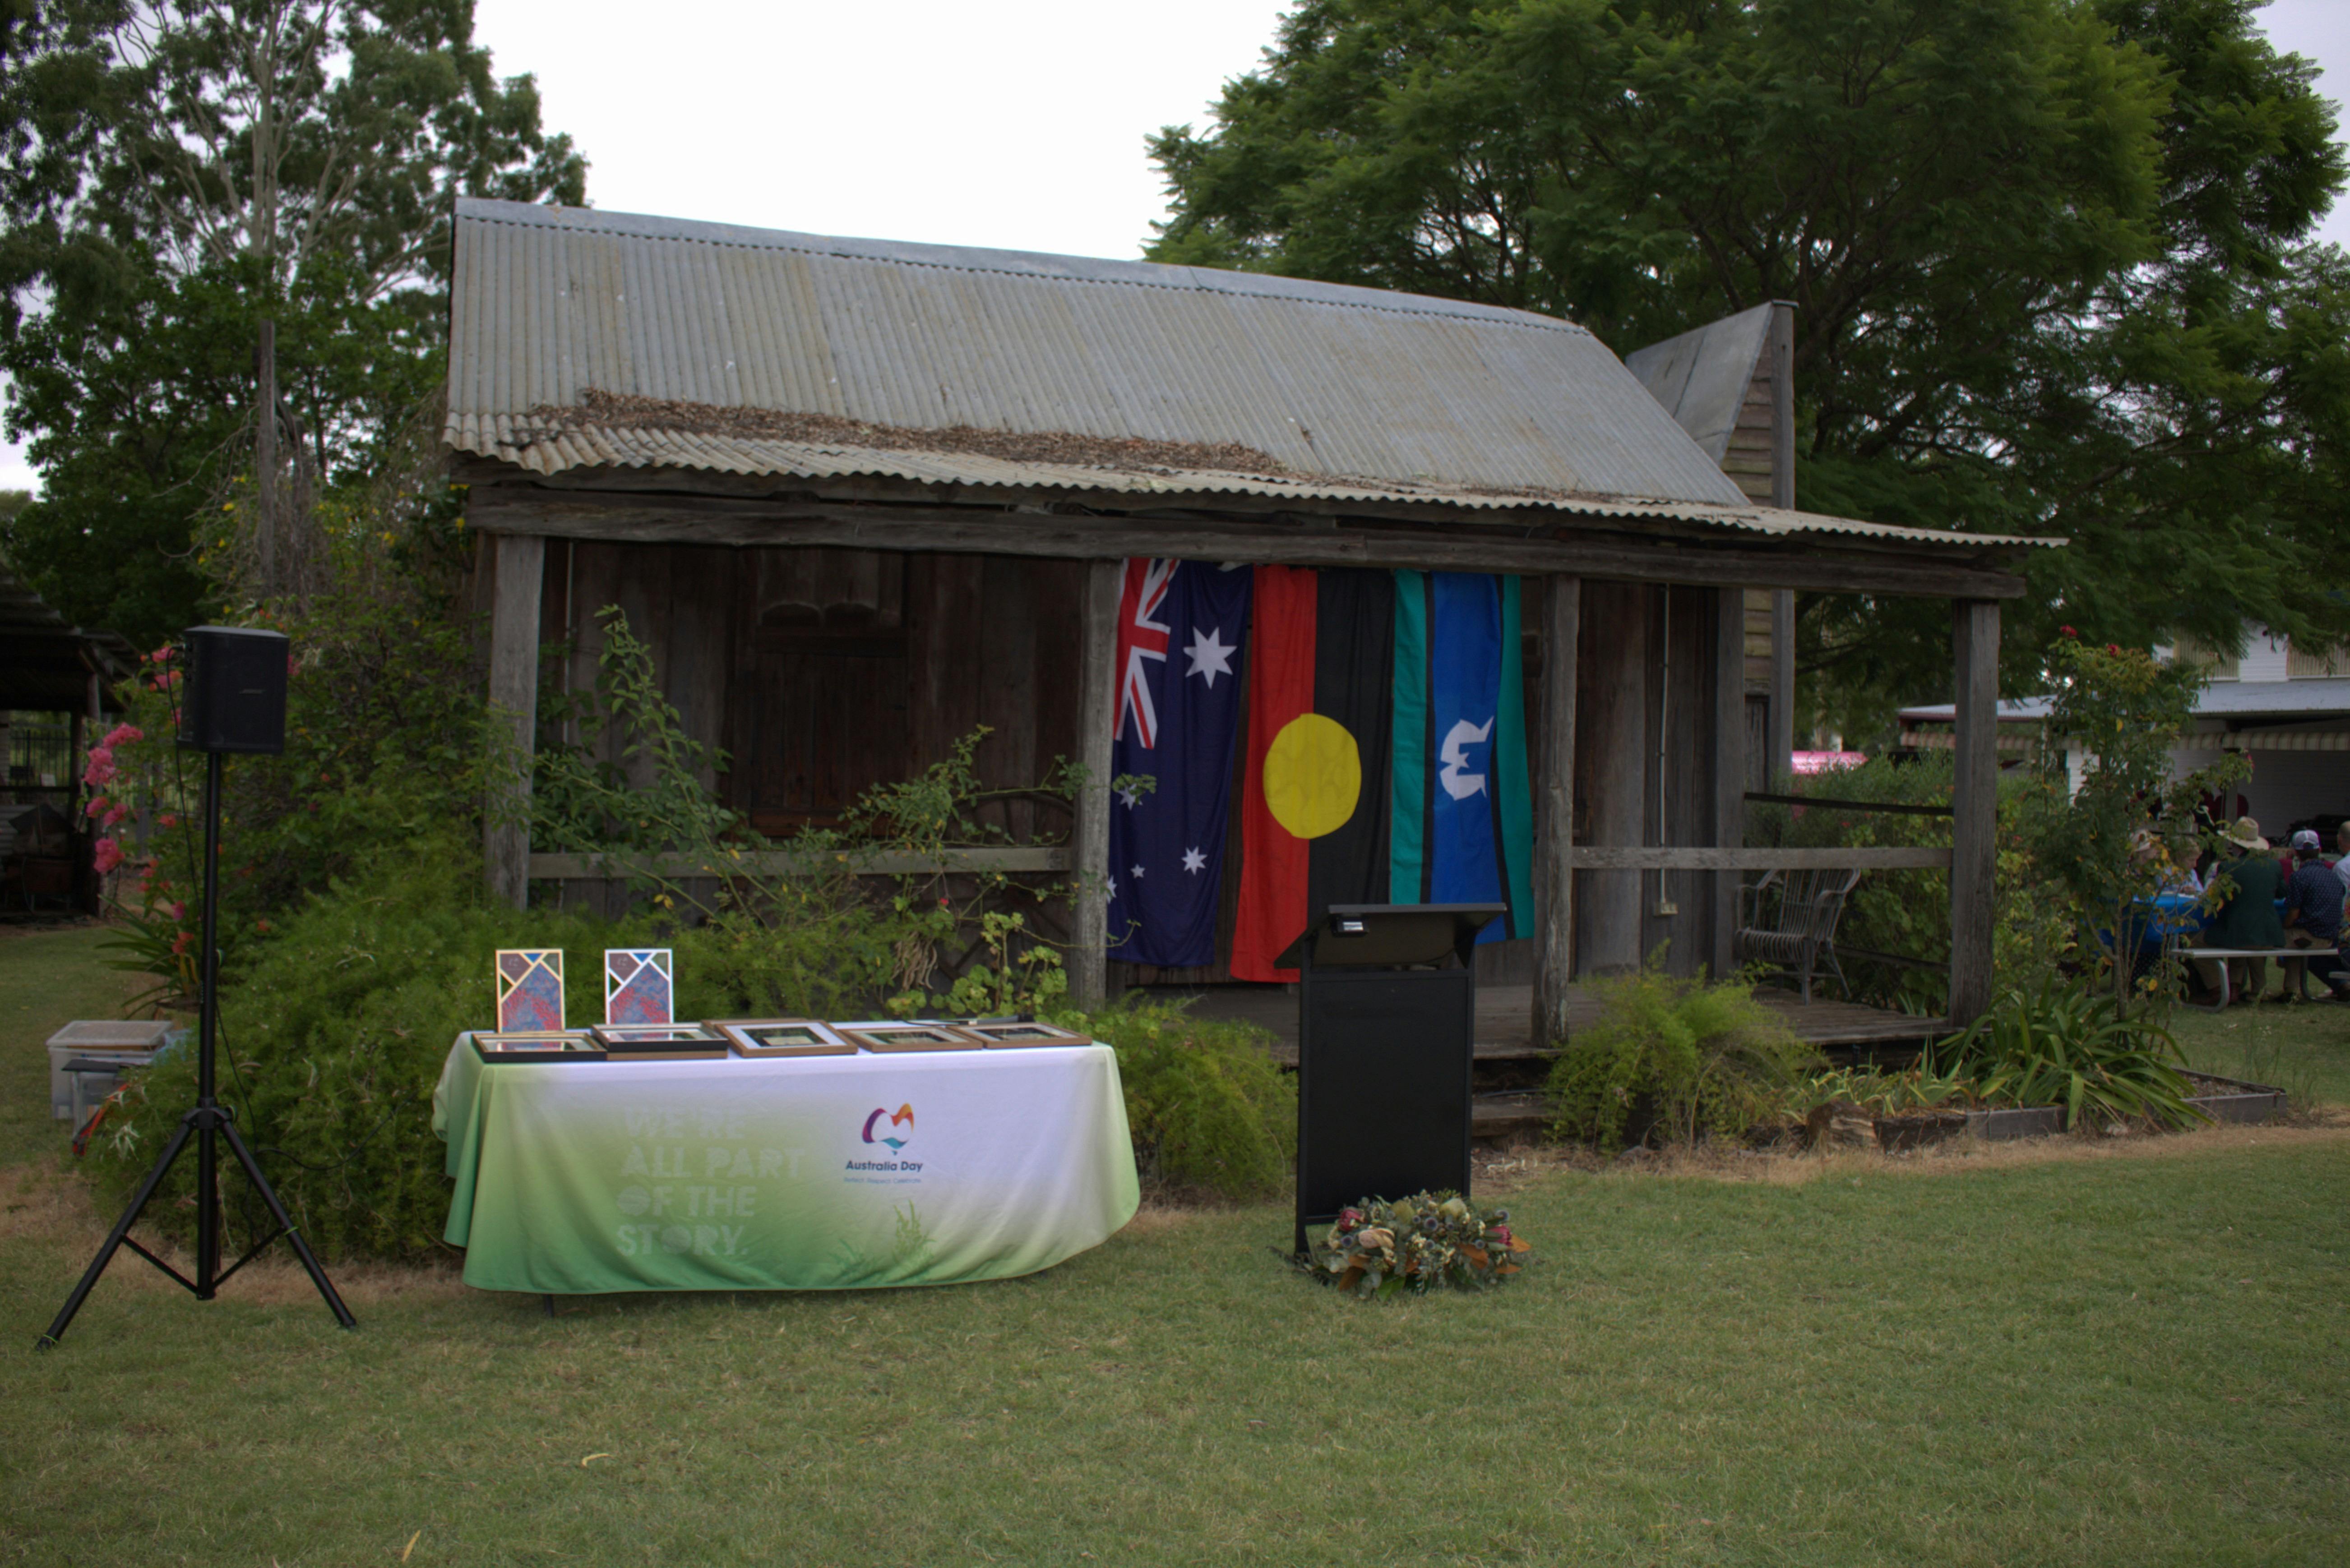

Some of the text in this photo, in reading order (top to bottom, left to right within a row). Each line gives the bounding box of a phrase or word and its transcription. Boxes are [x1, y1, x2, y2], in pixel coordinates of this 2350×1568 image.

[621, 1146, 805, 1178] ALL PART
[846, 1160, 923, 1172] Australia Day
[617, 1185, 757, 1217] OF THE
[616, 1224, 749, 1257] STORY.
